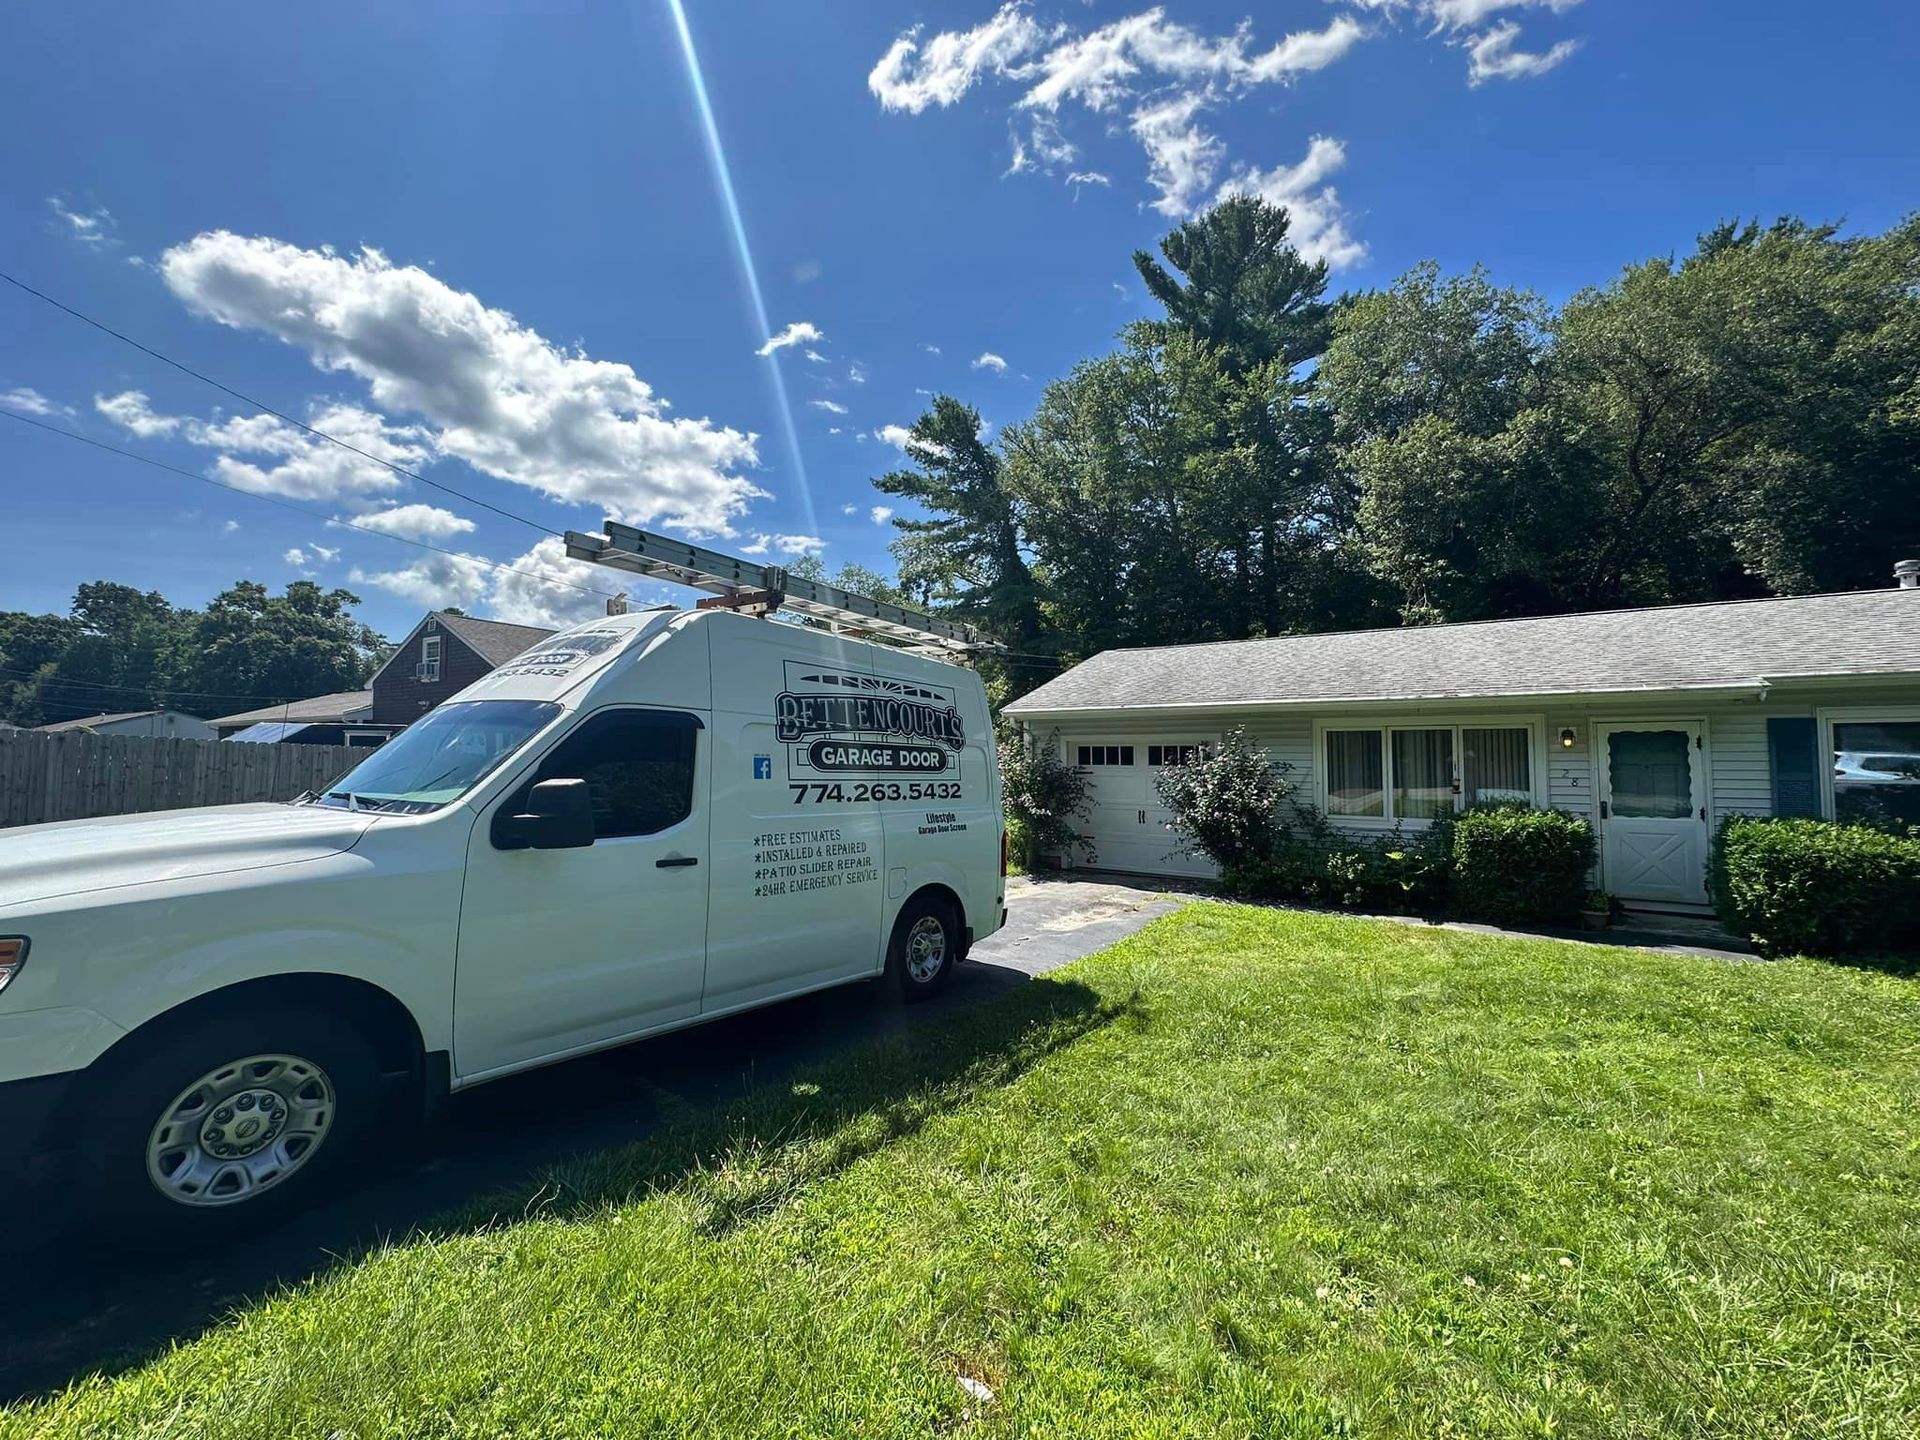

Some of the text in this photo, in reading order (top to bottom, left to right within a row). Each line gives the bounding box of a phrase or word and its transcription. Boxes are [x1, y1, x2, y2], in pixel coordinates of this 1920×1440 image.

[779, 697, 965, 746] BETTENCOURT'S
[821, 747, 940, 767] GARAGE DOOR
[789, 783, 962, 804] 774.263.5432
[926, 812, 956, 824] Lifestyle
[790, 829, 841, 844] ESTIMATES
[918, 824, 967, 835] Garage Door Screen
[816, 846, 823, 857] &
[826, 842, 867, 857] REPAIRED
[800, 860, 834, 875] SLIDER
[838, 856, 872, 870] REPAIR
[790, 871, 844, 893] EMERGENCY
[847, 869, 878, 885] SERVICE
